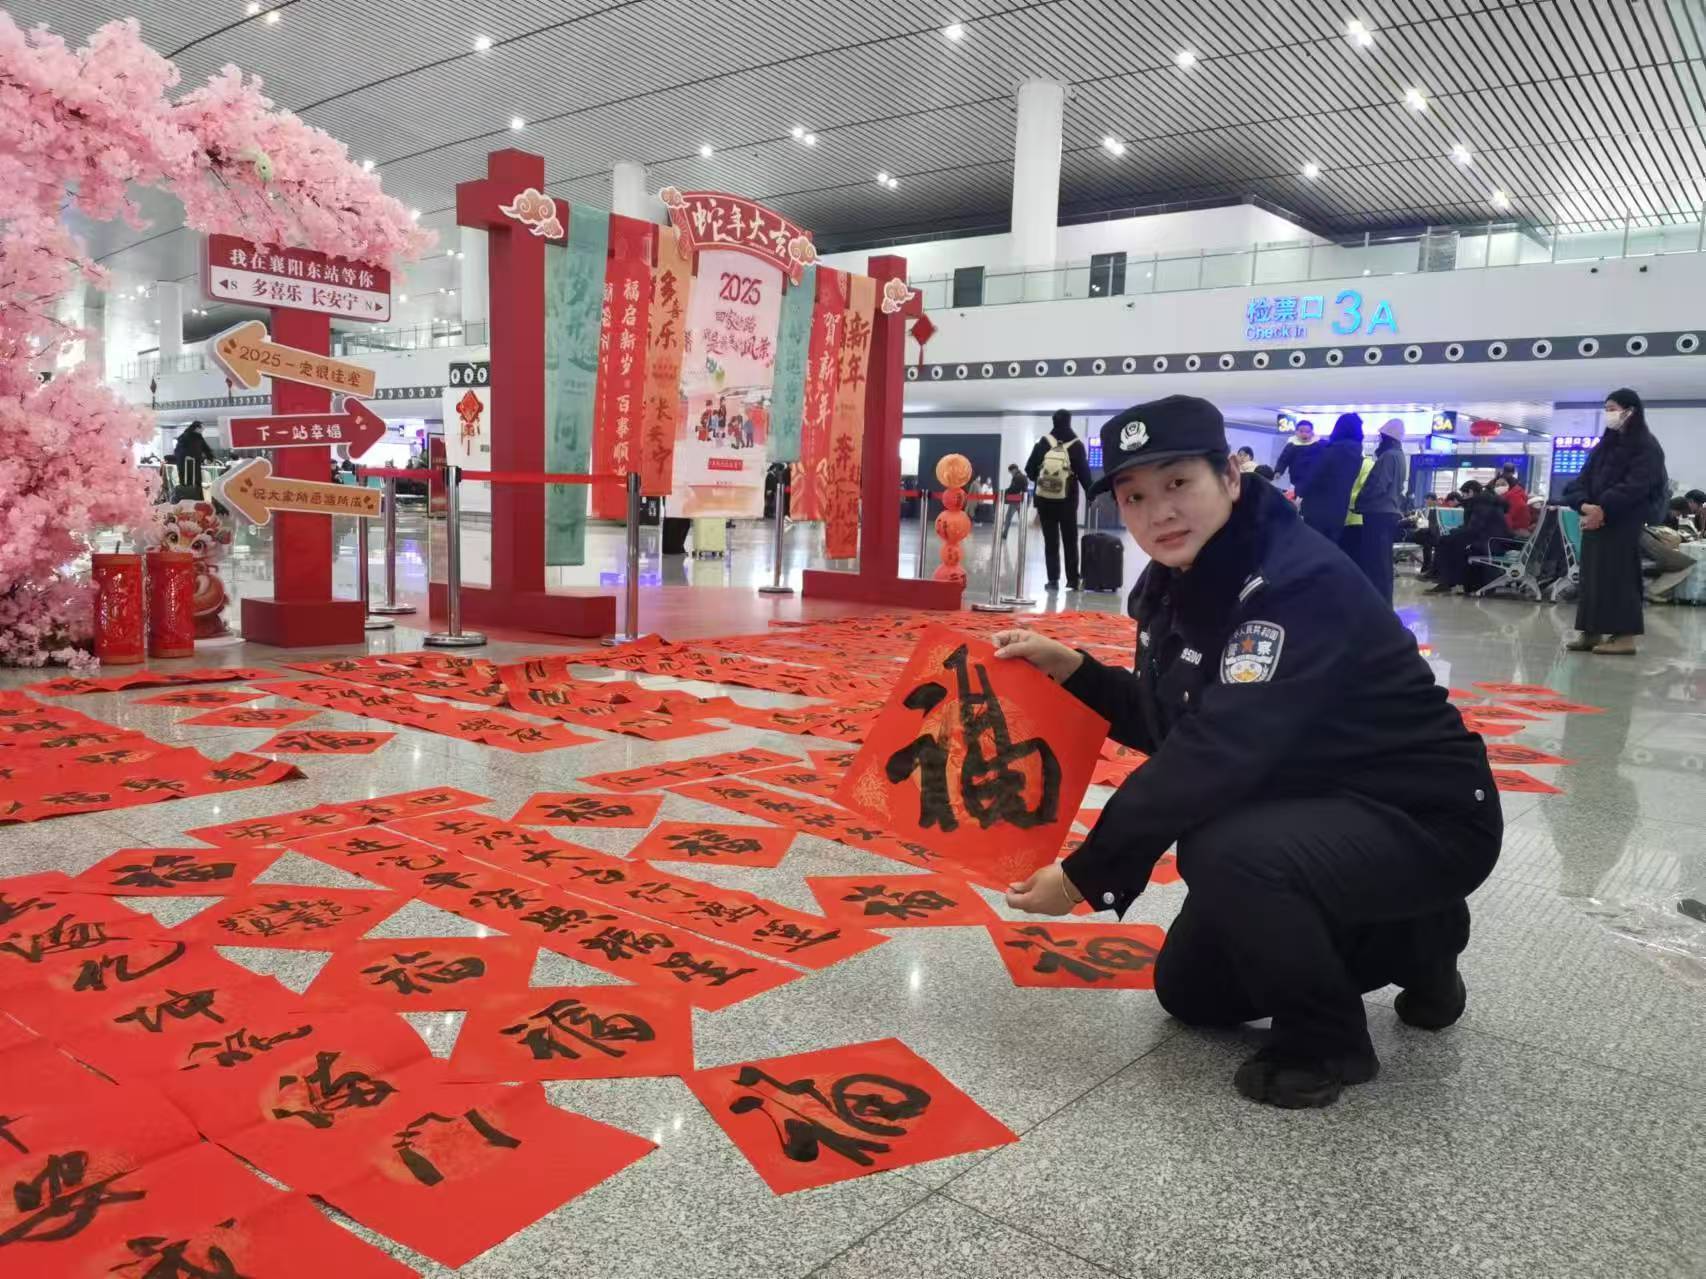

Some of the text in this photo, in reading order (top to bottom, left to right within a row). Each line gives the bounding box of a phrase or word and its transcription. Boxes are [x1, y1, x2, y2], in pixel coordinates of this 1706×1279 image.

[692, 200, 792, 258] 蛇年大吉
[229, 249, 374, 289] 我在襄阳东站等你
[230, 278, 373, 311] S 多喜乐 长安宁 N
[720, 272, 763, 305] 2025
[655, 269, 683, 350] 多喜乐
[1247, 290, 1398, 335] 检票口 3A
[1246, 326, 1291, 339] Check
[256, 425, 342, 442] 下一站幸福
[645, 398, 673, 477] 长安宁
[1278, 418, 1296, 432] 3A
[1433, 415, 1453, 431] 3A
[887, 643, 1062, 833] 福
[536, 797, 635, 823] 福
[663, 828, 764, 858] 福
[111, 854, 236, 888] 福
[840, 885, 959, 920] 福
[361, 950, 487, 995] 福
[1003, 925, 1160, 983] 福
[499, 999, 656, 1060] 福
[728, 1065, 931, 1167] 福
